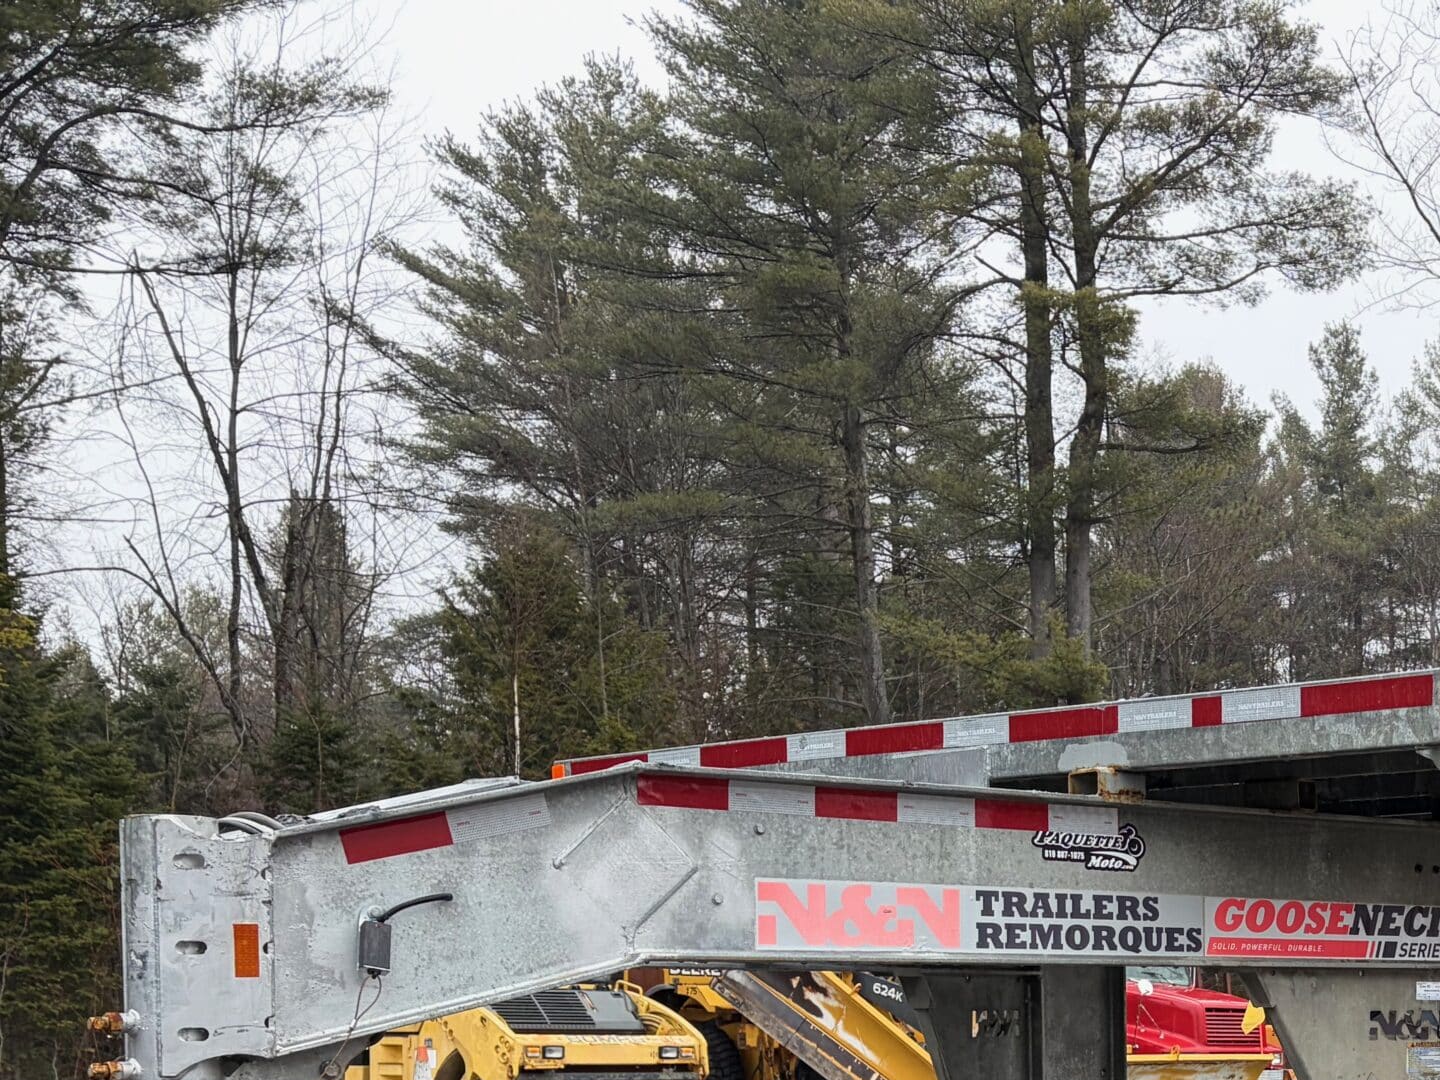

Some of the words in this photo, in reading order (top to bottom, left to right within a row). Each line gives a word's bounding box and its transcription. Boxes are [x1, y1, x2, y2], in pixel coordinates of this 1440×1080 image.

[1034, 831, 1123, 848] PAQUETTE
[757, 881, 960, 948] N&N
[975, 890, 1160, 921] TRAILERS
[975, 922, 1202, 953] REMORQUES
[1211, 942, 1239, 951] SOLID.
[1241, 943, 1285, 952] POWERFUL.
[1287, 944, 1325, 953] DURABLE.
[872, 982, 904, 1003] 624K
